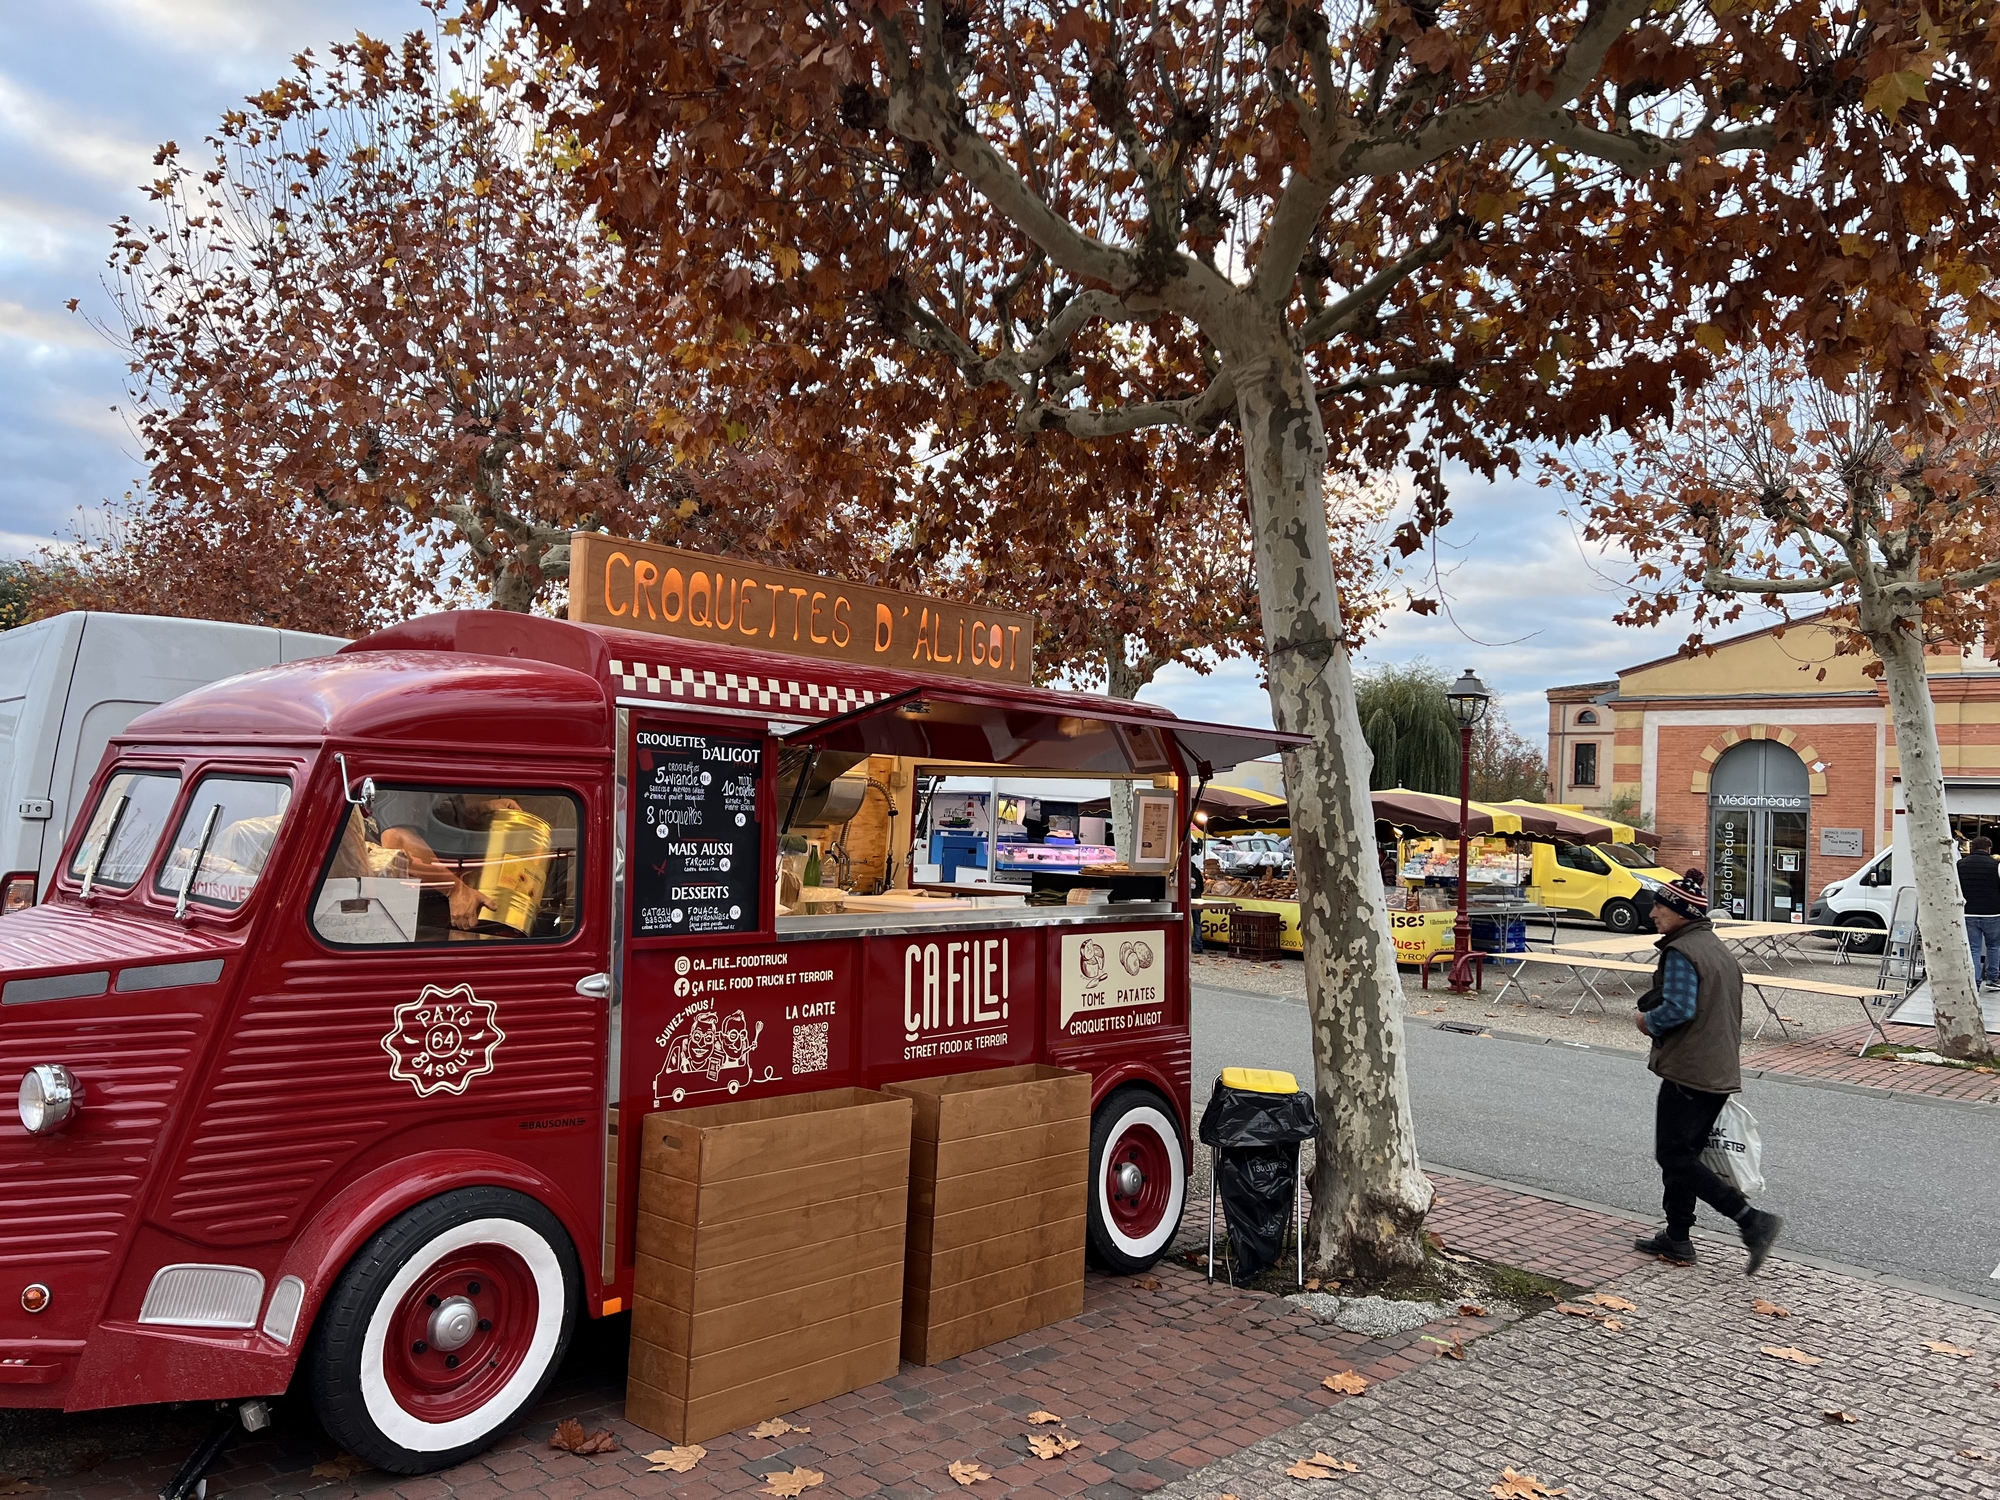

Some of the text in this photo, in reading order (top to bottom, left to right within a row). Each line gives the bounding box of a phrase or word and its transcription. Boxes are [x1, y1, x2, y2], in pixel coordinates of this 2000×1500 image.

[605, 551, 851, 648] CROQUETTES
[636, 732, 706, 748] CROQUETTES
[702, 746, 760, 763] D'ALIGOT
[655, 766, 665, 783] 5
[721, 780, 735, 796] 10
[1718, 794, 1801, 808] Médiathèque
[646, 805, 655, 824] 8
[668, 842, 733, 855] MAIS AUSSI
[1721, 821, 1736, 912] Médiathèque
[671, 886, 730, 900] DESSERTS
[693, 953, 788, 971] CA_FILE_FOODTRUCK
[1396, 952, 1428, 961] EYRON
[691, 970, 834, 996] ÇA FILE, FOOD TRUCK ET TERROIR
[1081, 987, 1156, 1007] TOME PATATES
[415, 1004, 473, 1027] PAYS
[785, 1001, 836, 1020] LA CARTE
[1069, 1010, 1163, 1036] CROQUETTES D'ALIGOT
[431, 1031, 454, 1049] 64
[903, 1044, 937, 1060] STREET
[939, 1039, 963, 1056] FOOD
[975, 1033, 1008, 1049] TERROIR
[411, 1047, 474, 1078] BASQUE
